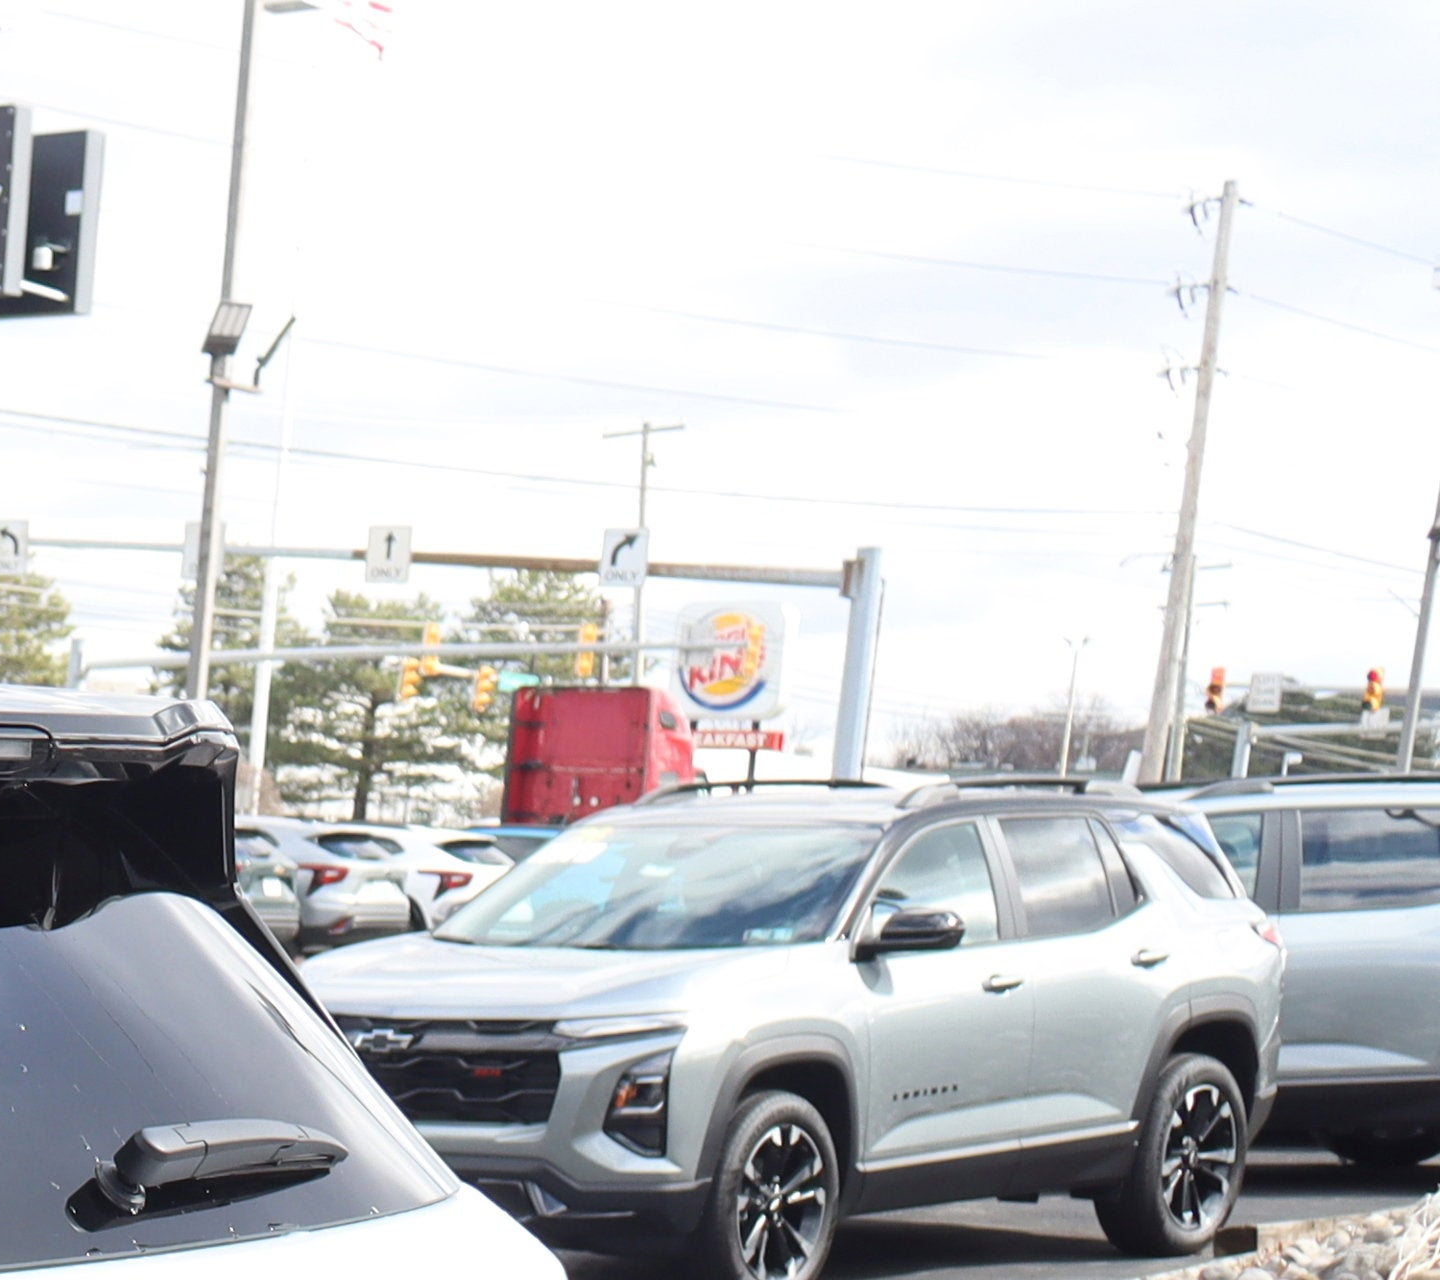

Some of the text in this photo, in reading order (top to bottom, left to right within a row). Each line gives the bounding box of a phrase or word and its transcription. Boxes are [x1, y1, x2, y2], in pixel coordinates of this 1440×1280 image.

[370, 565, 403, 577] ONLY
[604, 568, 638, 581] ONLY
[693, 733, 767, 748] EAKFAST
